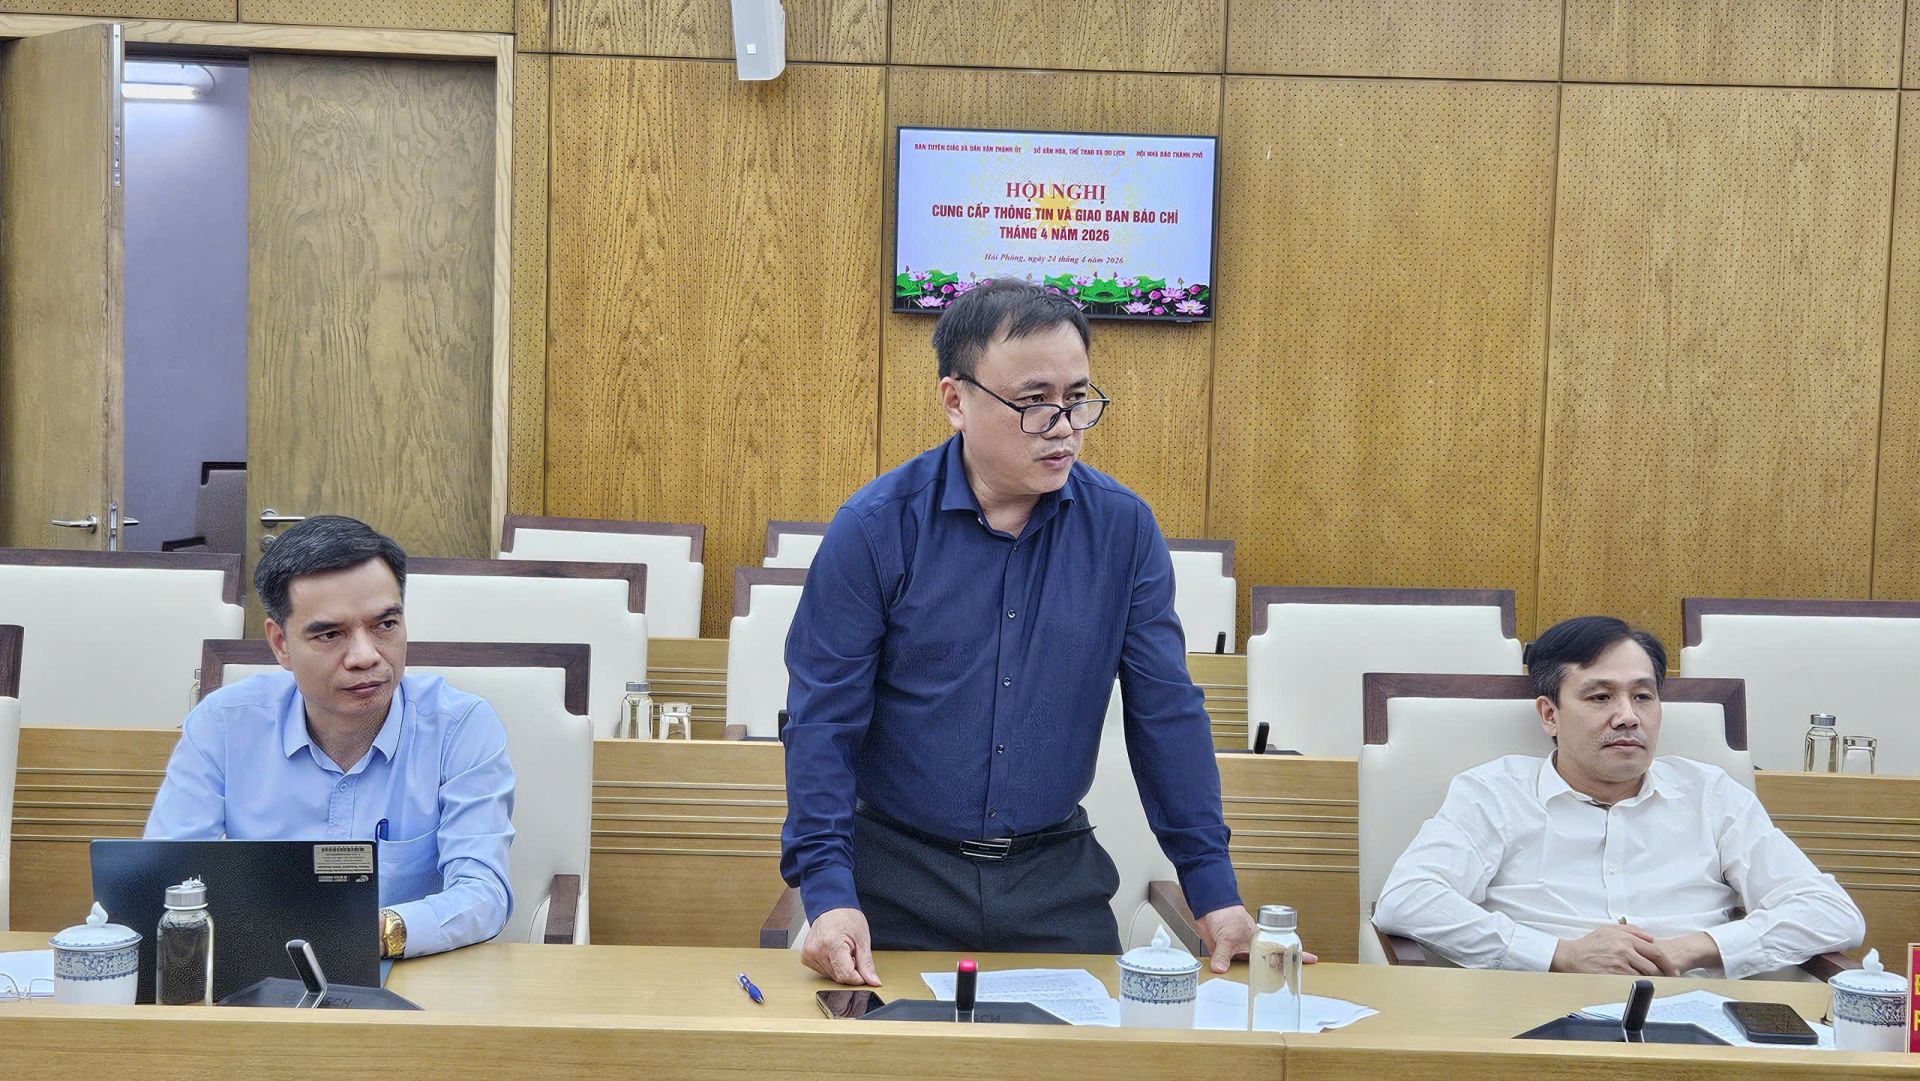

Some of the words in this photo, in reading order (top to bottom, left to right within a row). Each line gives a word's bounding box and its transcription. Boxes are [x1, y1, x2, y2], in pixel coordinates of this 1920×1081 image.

[1006, 180, 1045, 202] HỘI
[1052, 183, 1106, 205] NGHỊ
[932, 204, 964, 218] CUNG
[967, 202, 990, 218] CẤP
[994, 204, 1032, 220] THÔNG
[1035, 207, 1054, 220] TIN
[1057, 206, 1072, 221] VÀ
[1076, 209, 1102, 222] GIAO
[1106, 210, 1129, 223] BAN
[1133, 208, 1156, 224] BÁO
[1160, 209, 1179, 224] CHÍ
[1000, 224, 1037, 240] THÁNG
[1041, 228, 1048, 240] 4
[1051, 226, 1078, 241] NĂM
[1082, 229, 1110, 242] 2026
